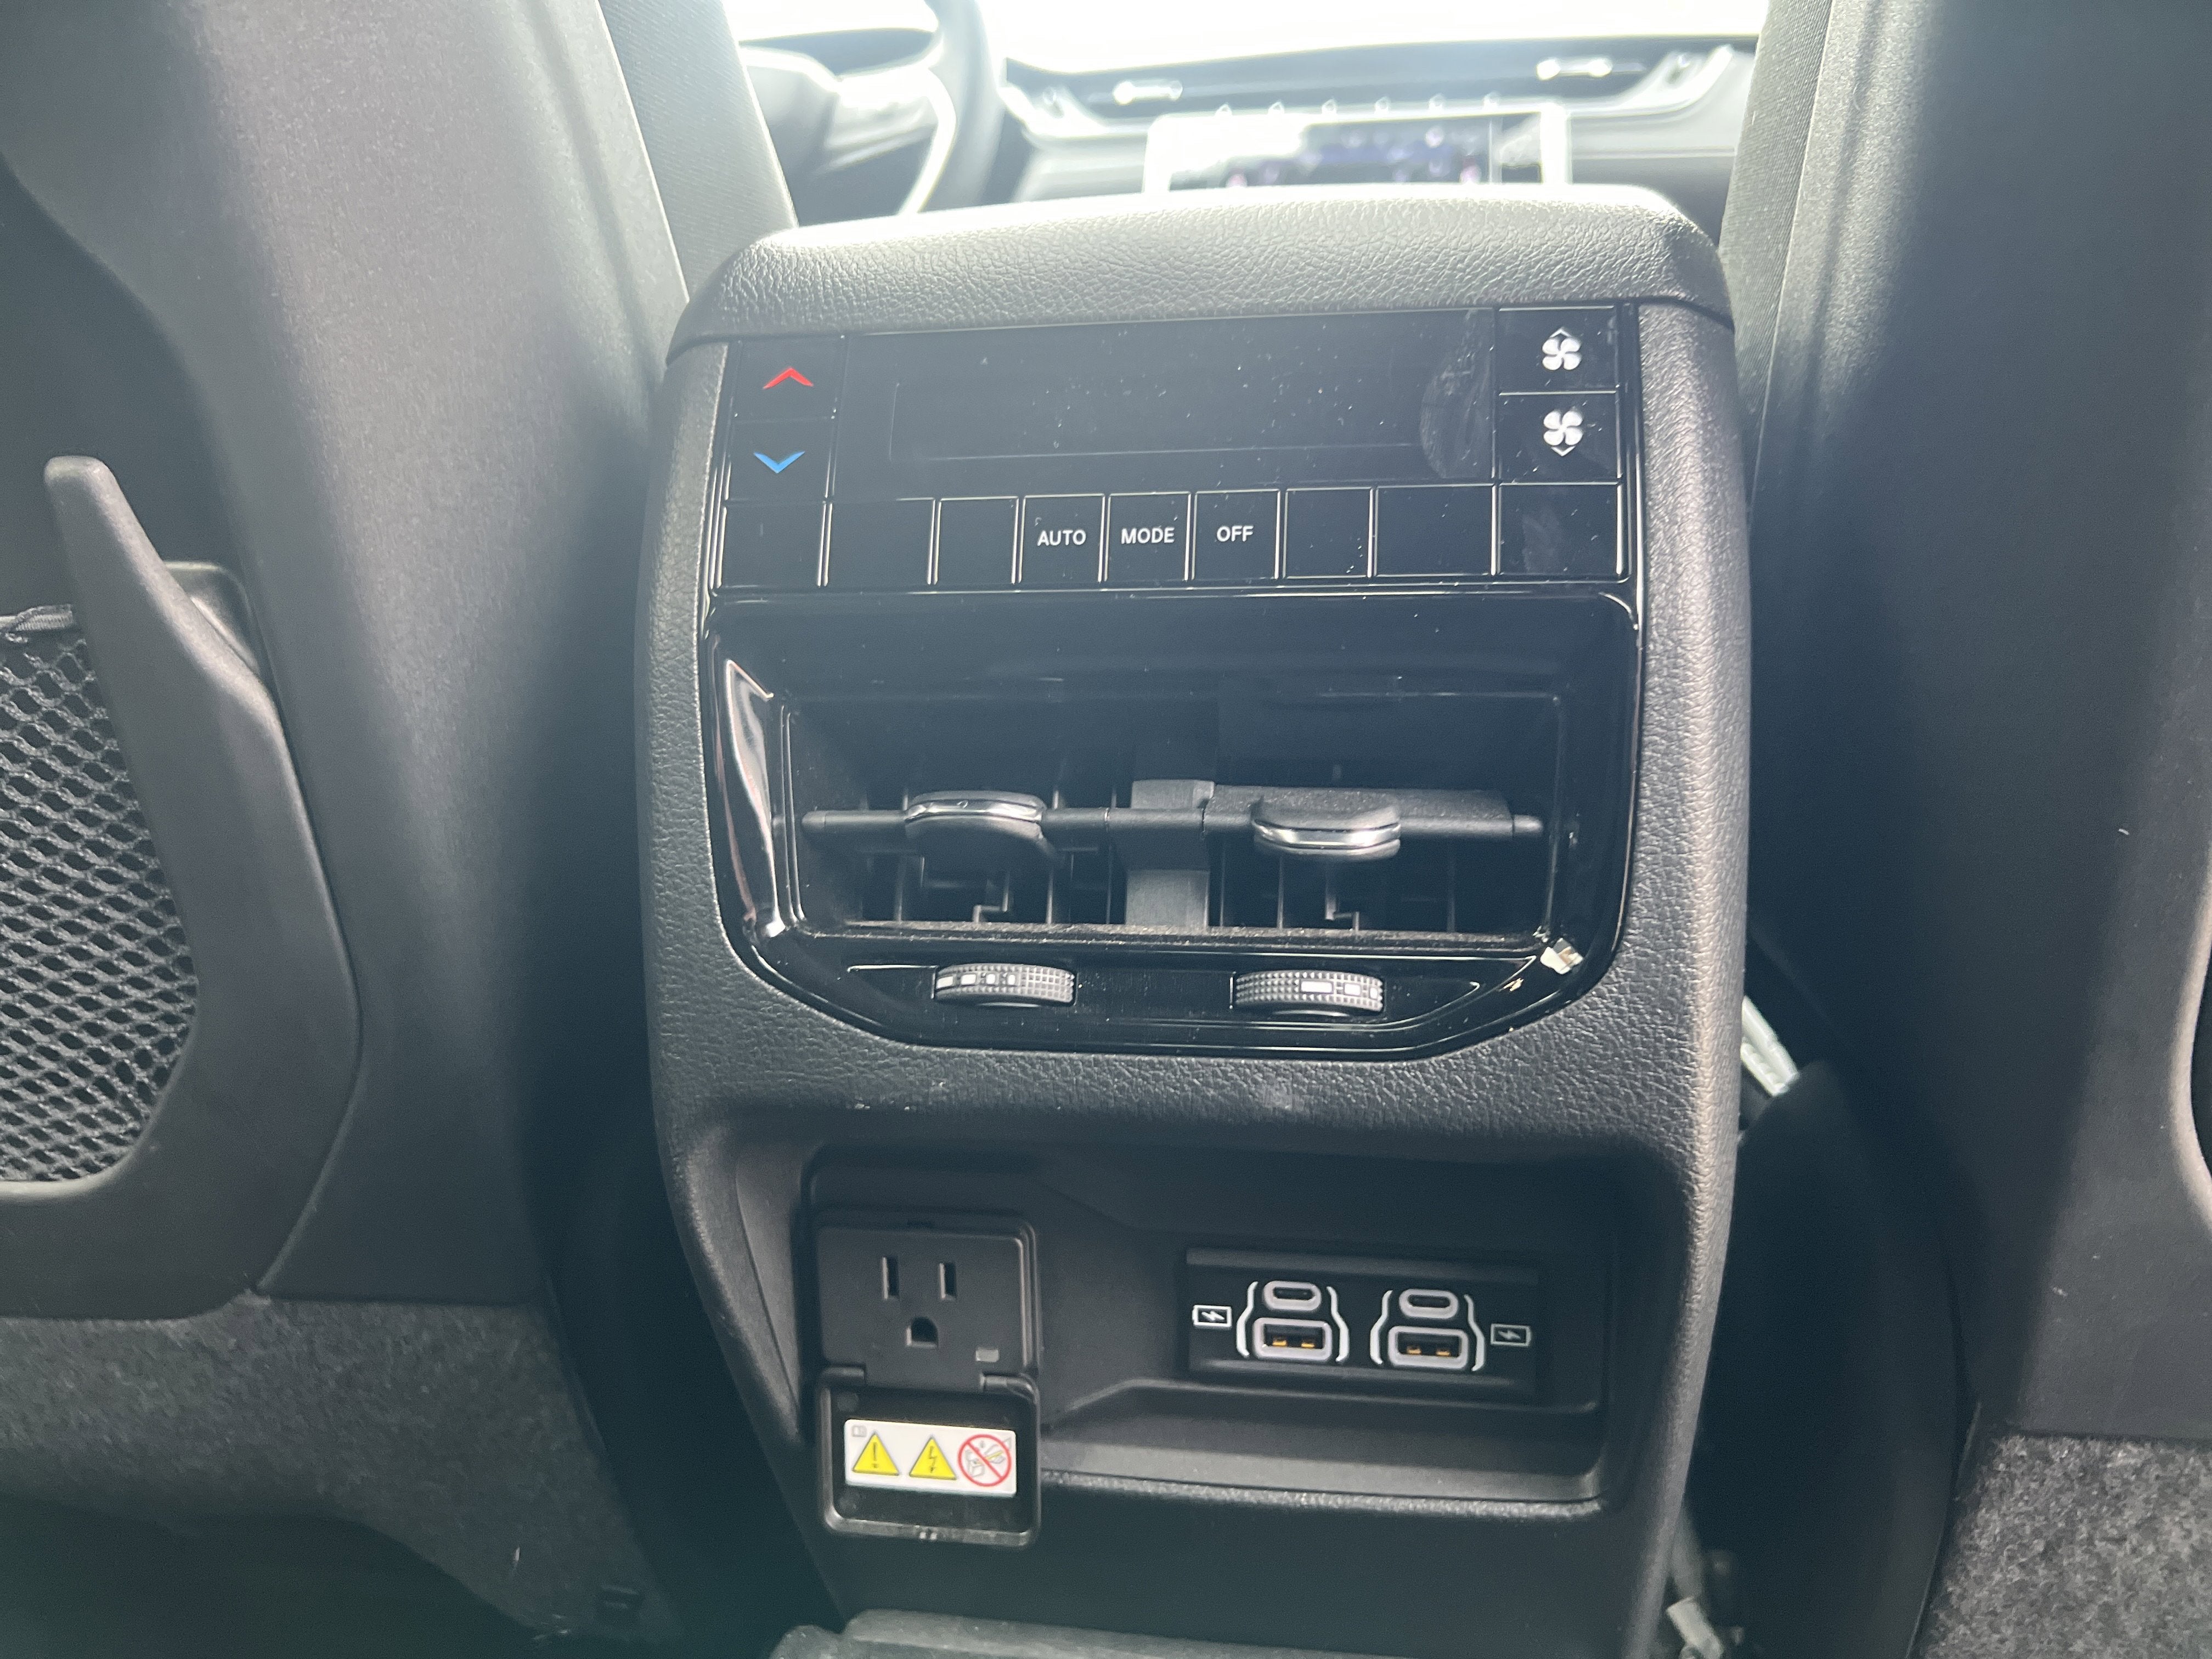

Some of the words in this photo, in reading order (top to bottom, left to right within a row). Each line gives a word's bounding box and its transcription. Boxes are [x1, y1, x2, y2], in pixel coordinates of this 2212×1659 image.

[1037, 529, 1087, 546] AUTO
[1120, 526, 1175, 544] MODE
[1216, 524, 1254, 543] OFF
